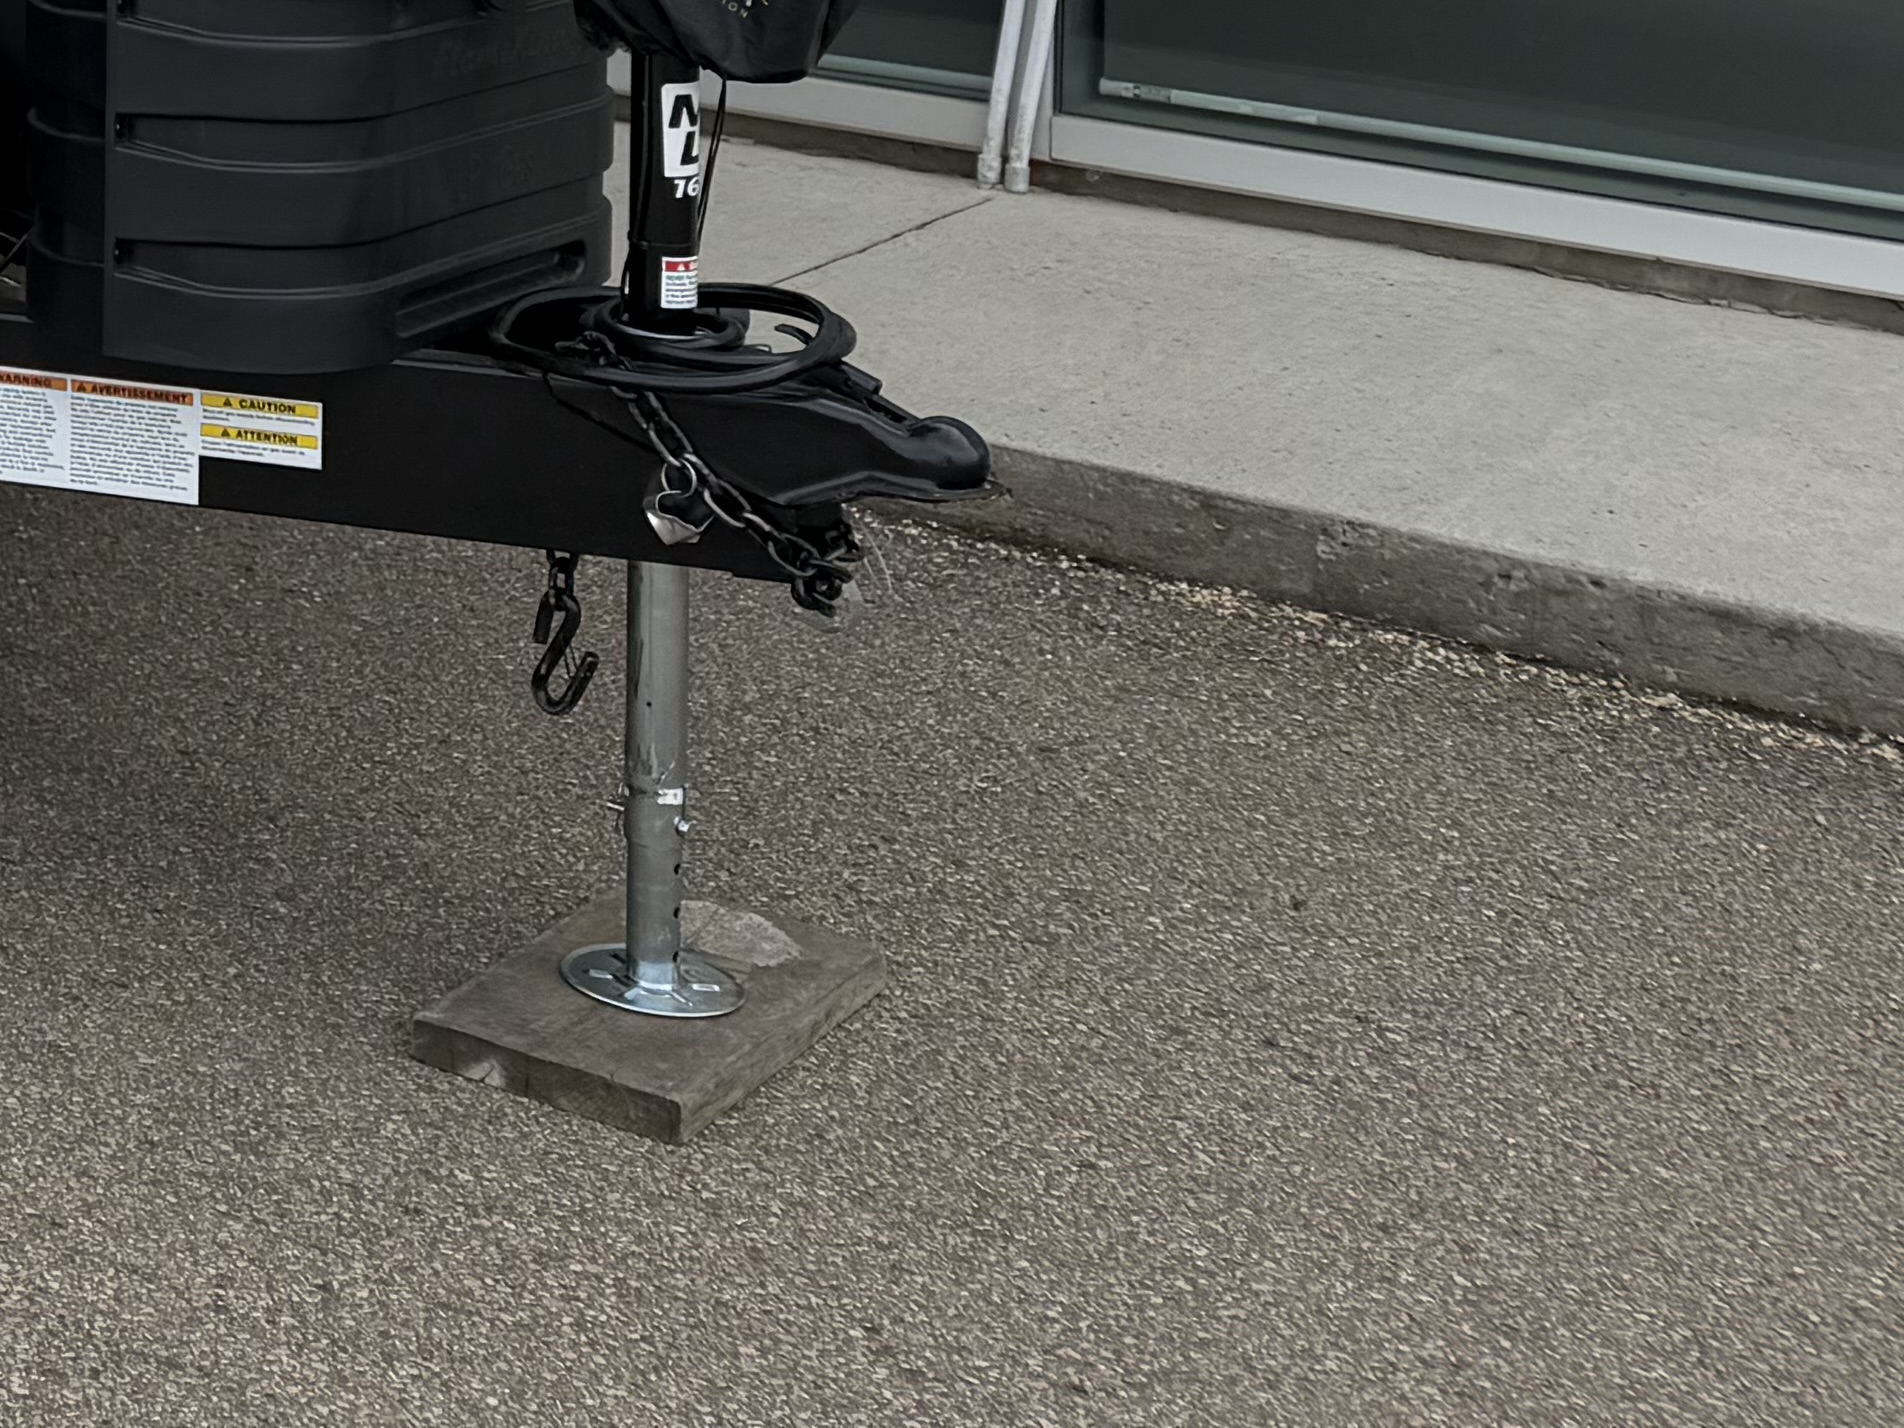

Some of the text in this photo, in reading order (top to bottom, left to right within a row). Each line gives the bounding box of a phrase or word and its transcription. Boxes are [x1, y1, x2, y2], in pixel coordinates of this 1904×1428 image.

[91, 384, 189, 404] AVERTISSEMENT
[238, 398, 297, 415] CAUTION
[235, 429, 298, 446] ATTENTION
